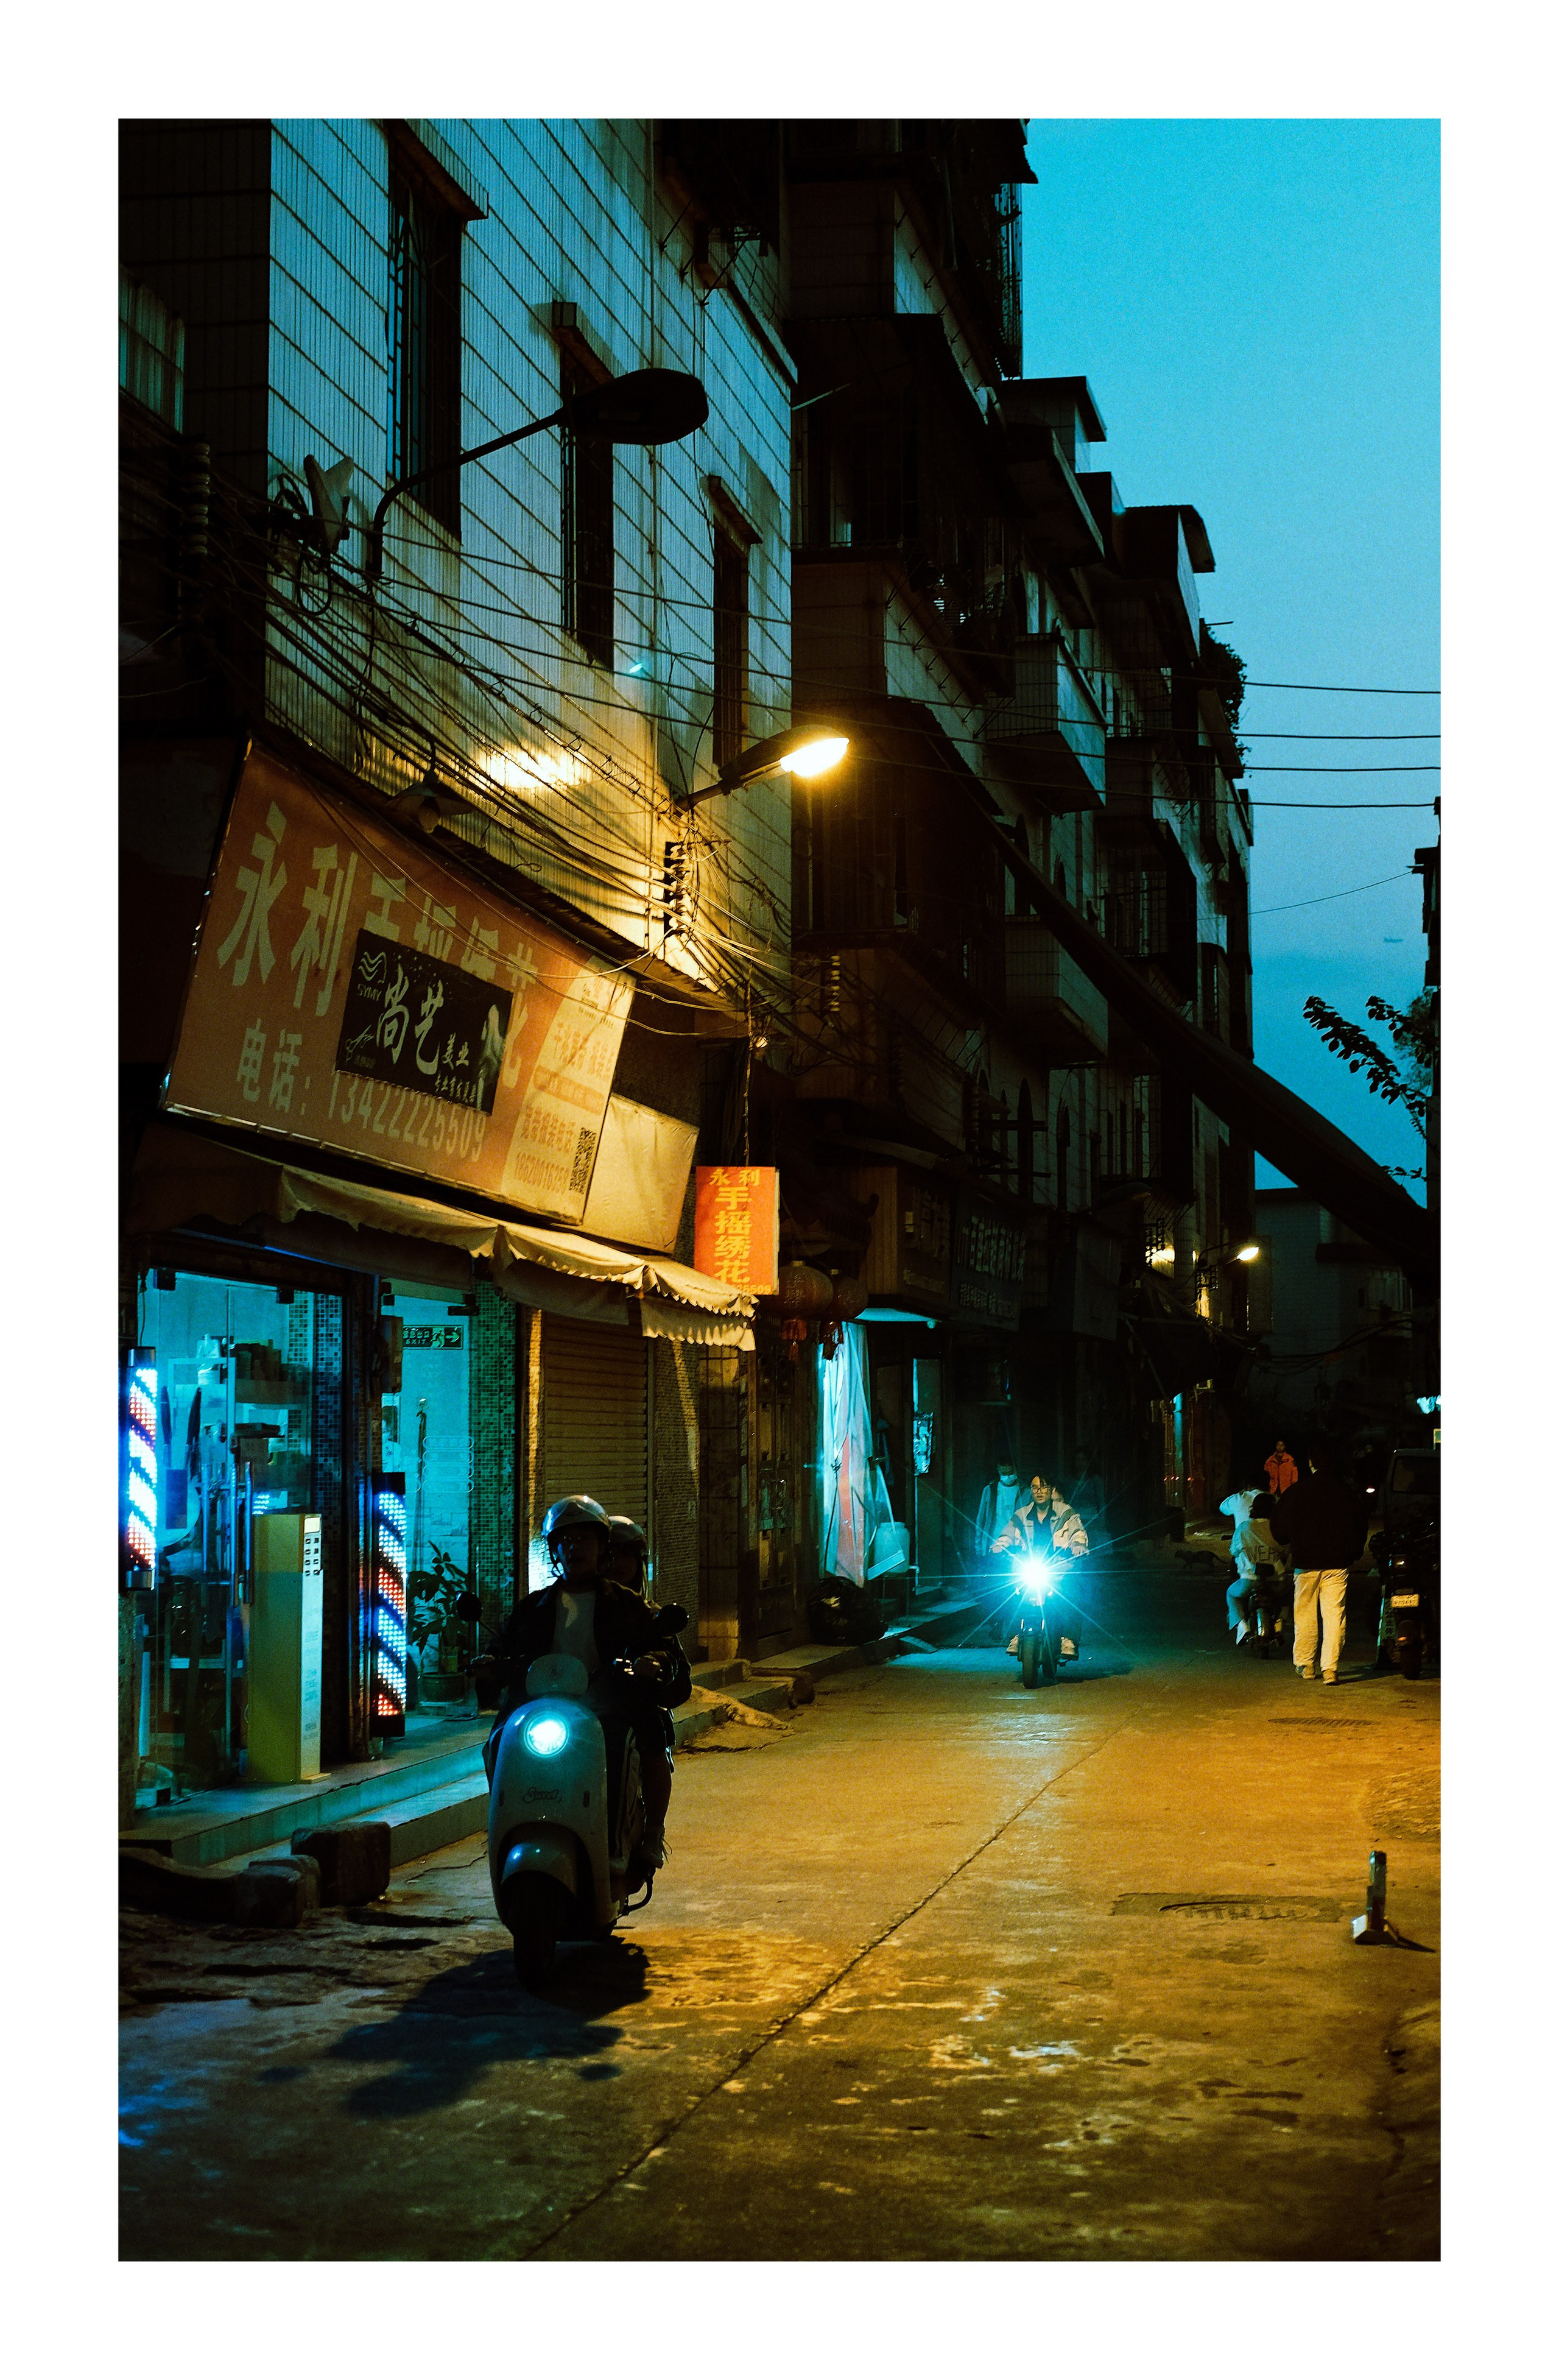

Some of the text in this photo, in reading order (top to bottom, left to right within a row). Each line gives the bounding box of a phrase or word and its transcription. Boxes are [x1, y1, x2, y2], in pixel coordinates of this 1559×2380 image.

[709, 1168, 760, 1187] 永利
[714, 1186, 752, 1284] 手摇绣花
